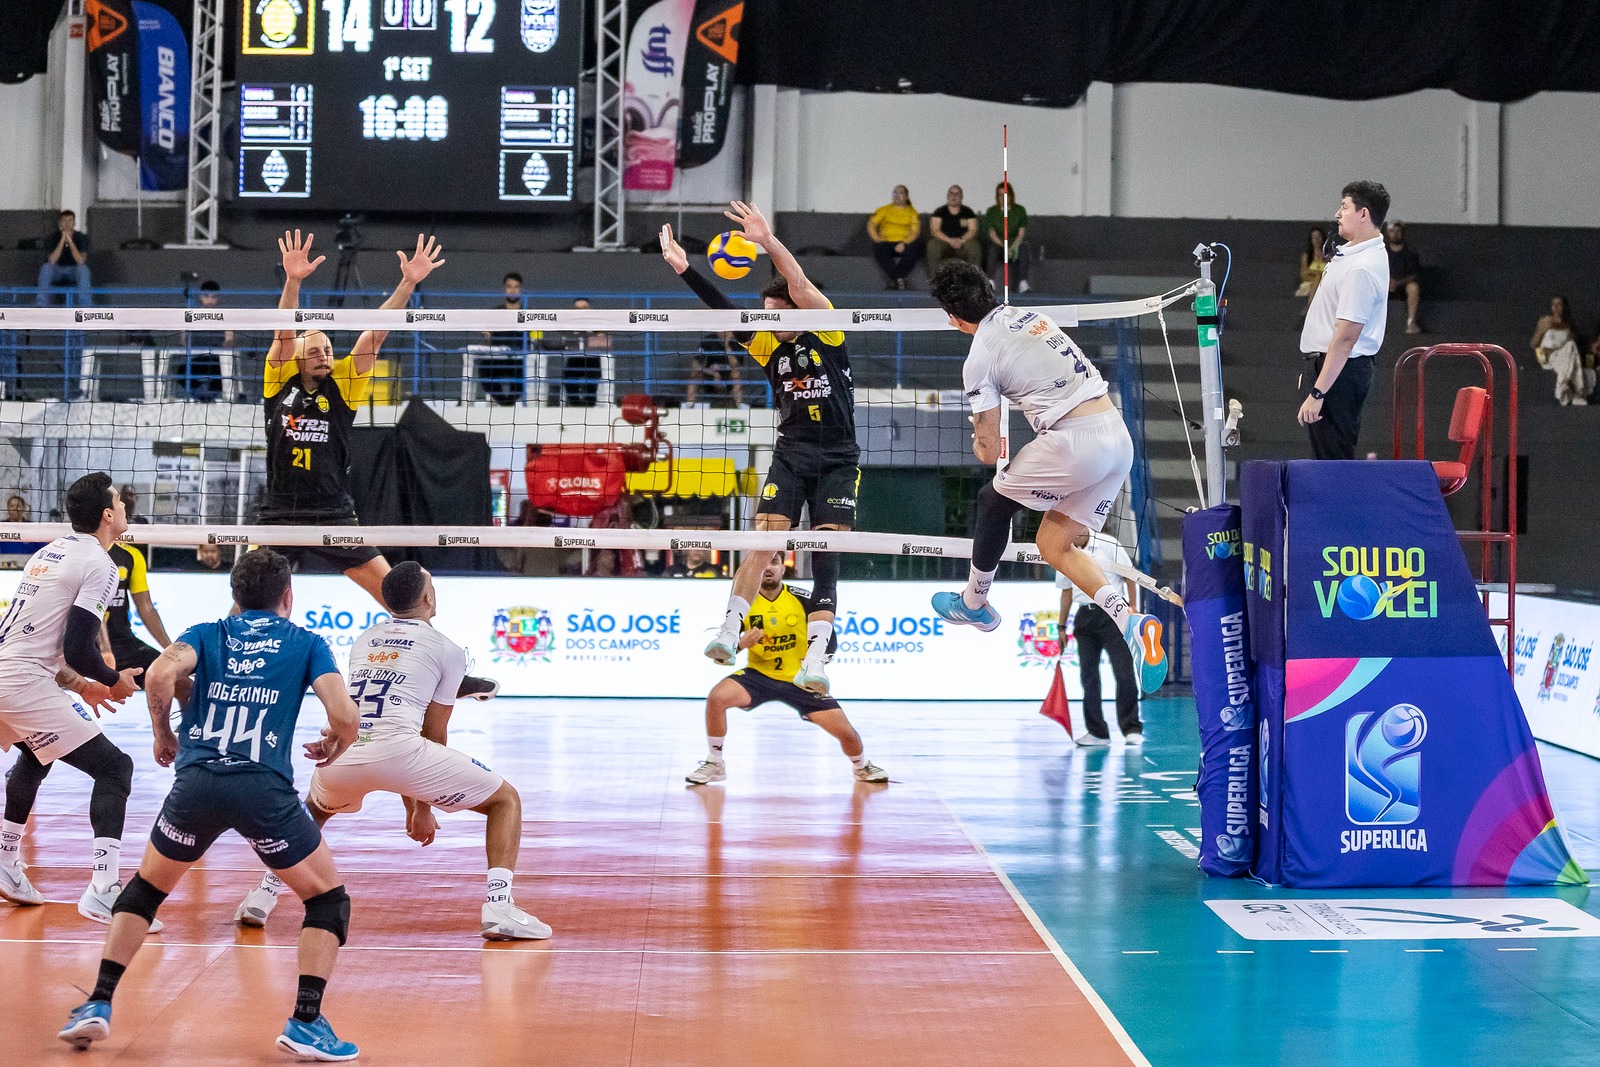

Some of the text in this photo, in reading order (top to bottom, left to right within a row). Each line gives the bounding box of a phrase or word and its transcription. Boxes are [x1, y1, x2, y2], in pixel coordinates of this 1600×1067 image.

[322, 0, 373, 51] 14
[444, 0, 496, 52] 12
[400, 56, 432, 81] SET
[107, 53, 121, 132] PROPLAY
[158, 46, 175, 152] BIANCO
[703, 63, 719, 144] PROPLAY
[83, 312, 114, 323] SUPERLIGA
[193, 312, 224, 323] SUPERLIGA
[304, 312, 335, 323] SUPERLIGA
[415, 312, 446, 323] SUPERLIGA
[526, 312, 557, 323] SUPERLIGA
[637, 312, 669, 323] SUPERLIGA
[750, 312, 781, 323] SUPERLIGA
[861, 312, 892, 323] SUPERLIGA
[808, 404, 821, 422] 5
[286, 429, 329, 442] POWER
[292, 447, 312, 471] 21
[559, 477, 601, 489] GLOBUS
[217, 535, 249, 544] SUPERLIGA
[332, 536, 364, 545] SUPERLIGA
[448, 536, 480, 545] SUPERLIGA
[564, 538, 596, 547] SUPERLIGA
[1206, 531, 1230, 545] SOU
[680, 540, 712, 549] SUPERLIGA
[796, 541, 828, 550] SUPERLIGA
[911, 545, 943, 555] SUPERLIGA
[1323, 546, 1426, 577] SOU DO
[305, 604, 353, 629] SÃO
[567, 608, 680, 633] SÃO JOSÉ
[244, 638, 281, 650] VINAC
[566, 638, 660, 650] DOS CAMPOS
[764, 641, 796, 652] POWER
[837, 641, 924, 652] OS CAMPOS
[774, 656, 783, 671] 2
[1220, 611, 1248, 706] SUPERLIGA
[207, 681, 280, 704] ROGÉRINHO
[203, 703, 268, 763] 44
[1227, 743, 1252, 835] SUPERLIGA
[1341, 829, 1428, 853] SUPERLIGA
